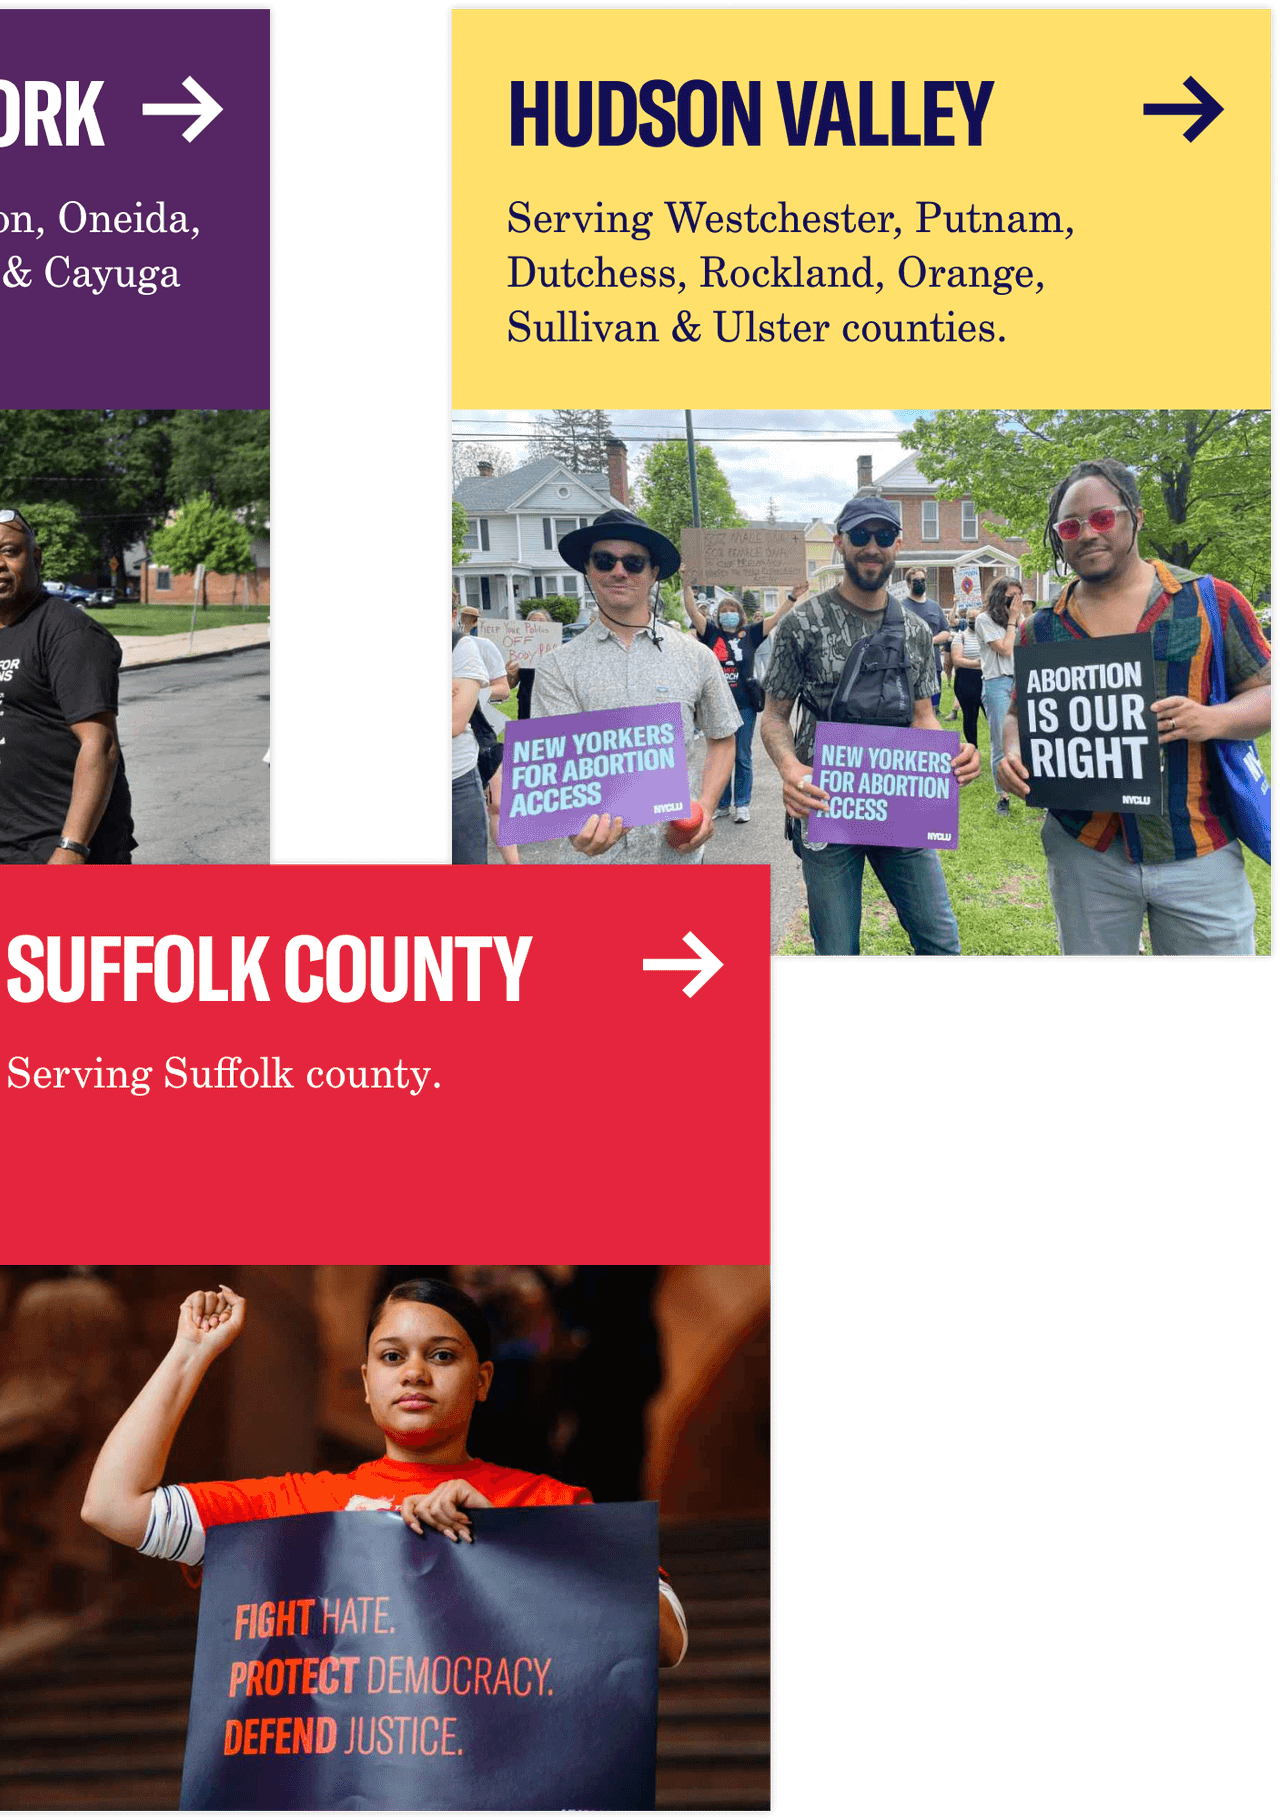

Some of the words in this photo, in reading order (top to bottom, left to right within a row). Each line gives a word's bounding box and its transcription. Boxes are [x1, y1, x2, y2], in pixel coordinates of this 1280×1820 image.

[1027, 661, 1142, 693] ABORTION
[1027, 697, 1059, 733] IS
[1069, 694, 1146, 732] OUR
[513, 735, 566, 763] NEW
[572, 723, 675, 755] YORKERS
[821, 744, 863, 768] NEW
[868, 747, 952, 774] YORKERS
[1030, 736, 1149, 779] RIGHT
[512, 763, 557, 790] FOR
[562, 747, 675, 782] ABORTION
[819, 770, 855, 793] FOR
[858, 772, 950, 799] ABORTION
[509, 782, 602, 818] ACCESS
[653, 802, 683, 814] NYCLU
[1122, 795, 1150, 805] NYCLU
[927, 832, 951, 841] NYCLU
[234, 1598, 315, 1641] FIGHT
[322, 1596, 395, 1635] HATE.
[229, 1656, 361, 1698] PROTECT
[367, 1655, 554, 1697] DEMOCRACY.
[224, 1715, 337, 1756] DEFEND
[344, 1715, 463, 1757] JUSTICE.
